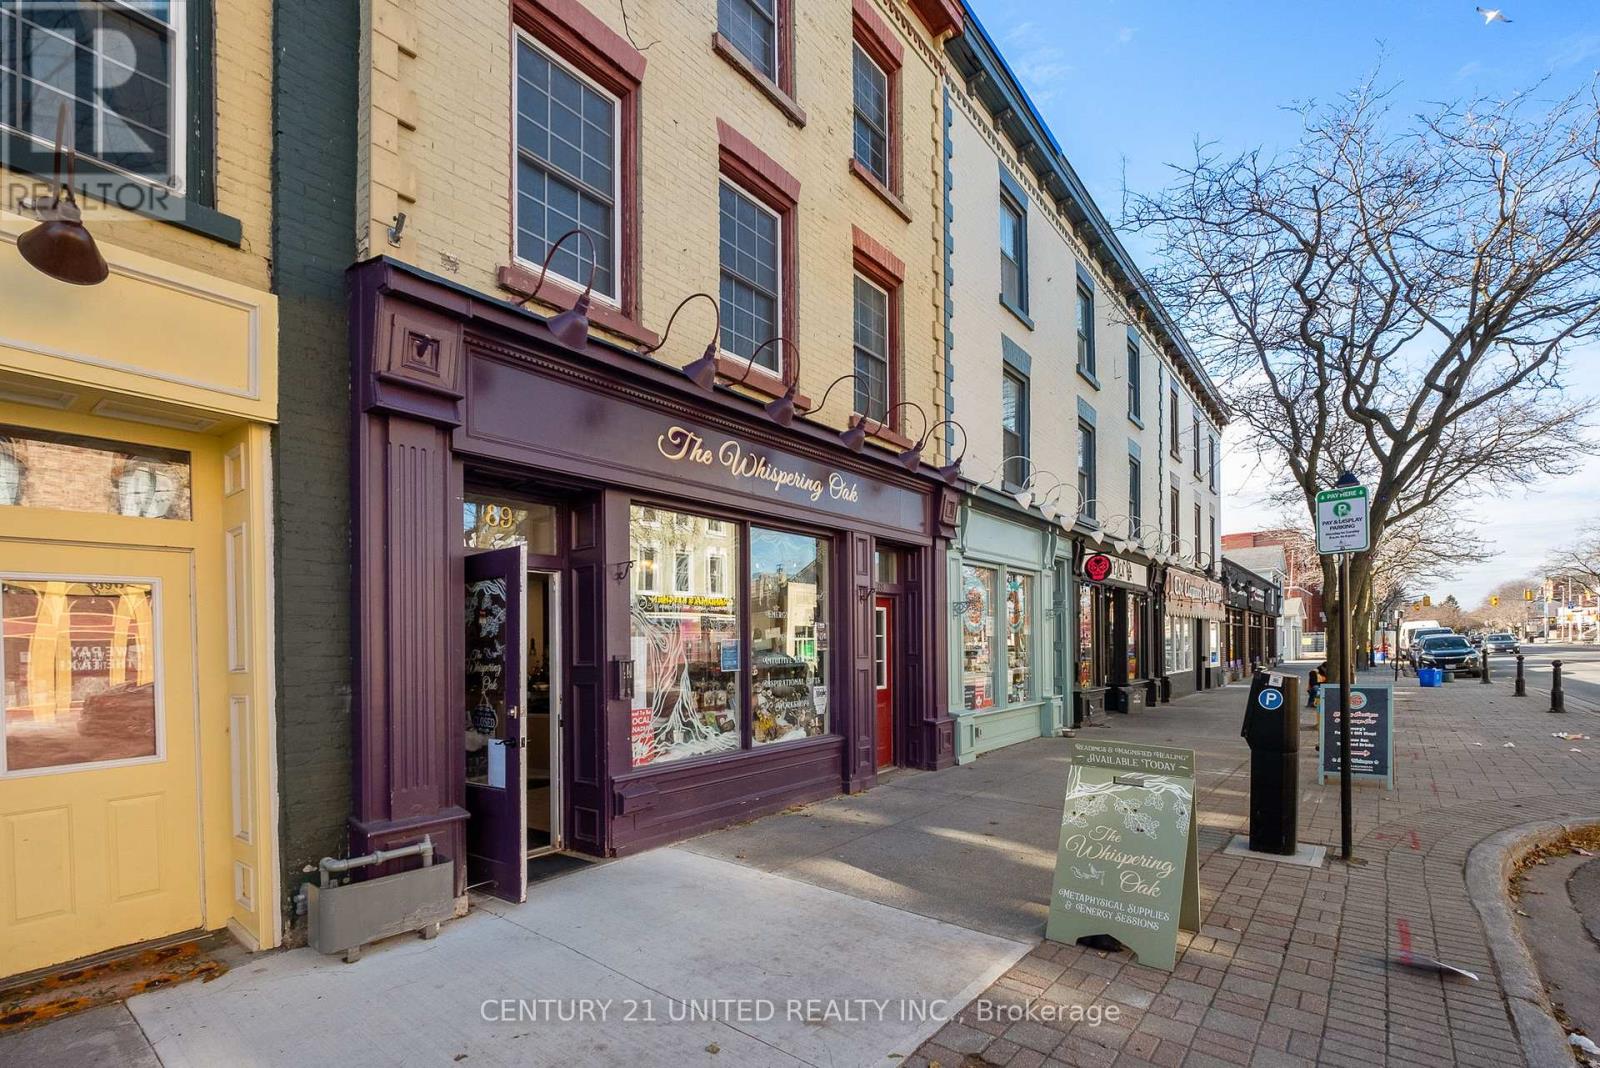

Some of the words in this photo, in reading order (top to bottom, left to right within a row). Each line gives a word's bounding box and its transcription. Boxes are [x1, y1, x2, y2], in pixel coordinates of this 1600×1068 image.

[657, 426, 713, 465] The
[719, 440, 824, 502] Whispering
[828, 472, 858, 503] Oak
[485, 503, 513, 529] 89
[482, 675, 498, 691] Oak
[632, 715, 651, 726] OCAL
[1074, 743, 1107, 753] READINGS
[1087, 753, 1139, 767] AVAILABLE
[1141, 758, 1176, 771] TODAY
[1088, 825, 1121, 843] The
[1065, 834, 1176, 879] Whispering
[1119, 870, 1161, 898] Oak
[1058, 888, 1126, 911] METAPHYSICAL
[1127, 903, 1170, 921] SUPPLIES
[1064, 900, 1072, 910] &
[1076, 903, 1113, 919] ENERGY
[1115, 913, 1160, 931] SESSIONS
